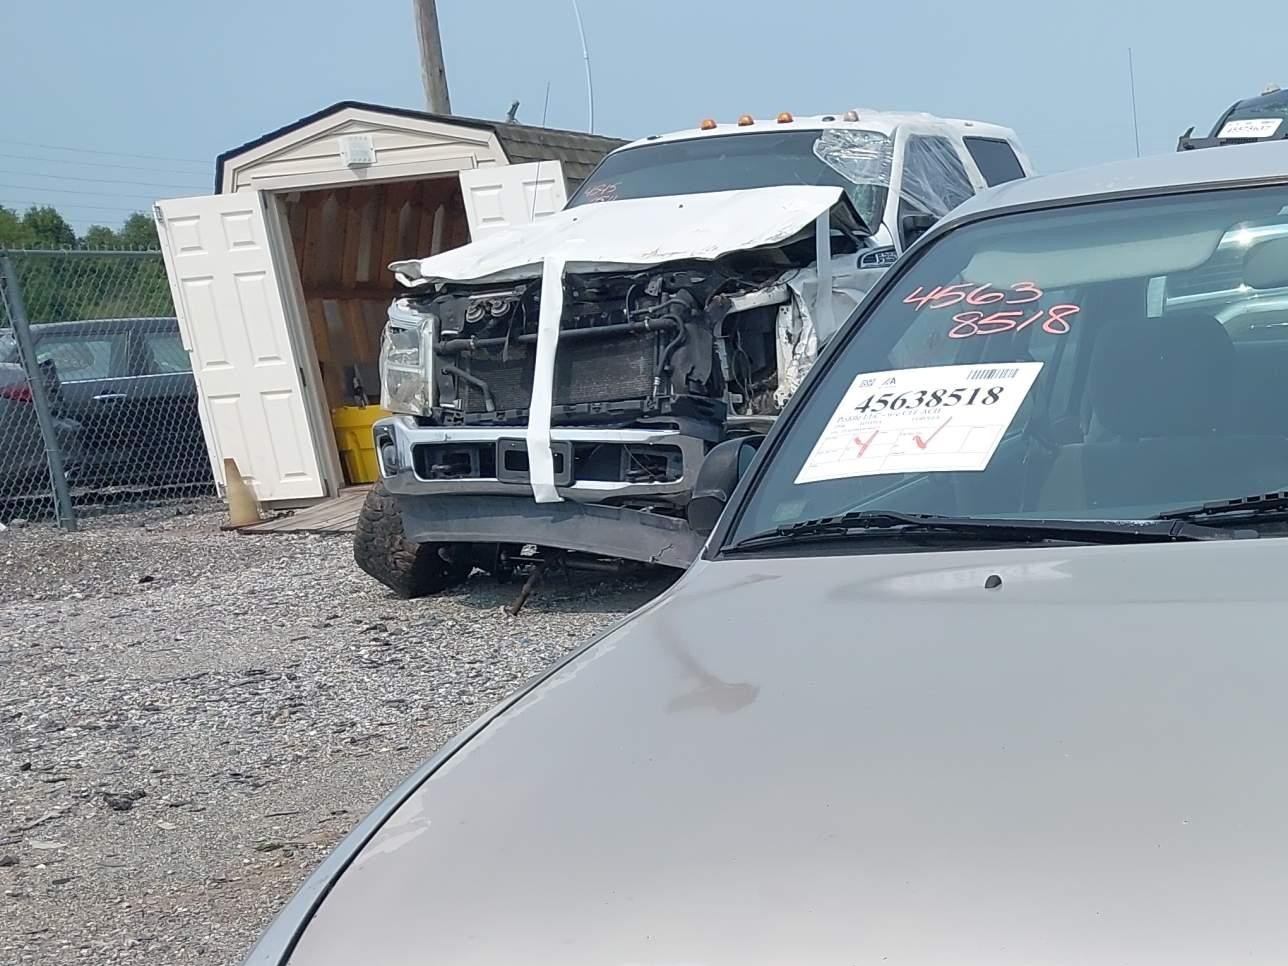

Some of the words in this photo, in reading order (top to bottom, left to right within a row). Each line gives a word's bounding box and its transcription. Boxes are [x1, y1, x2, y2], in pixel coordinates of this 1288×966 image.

[903, 281, 1044, 311] 4563
[949, 304, 1081, 338] 8518
[854, 386, 1005, 414] 45638518
